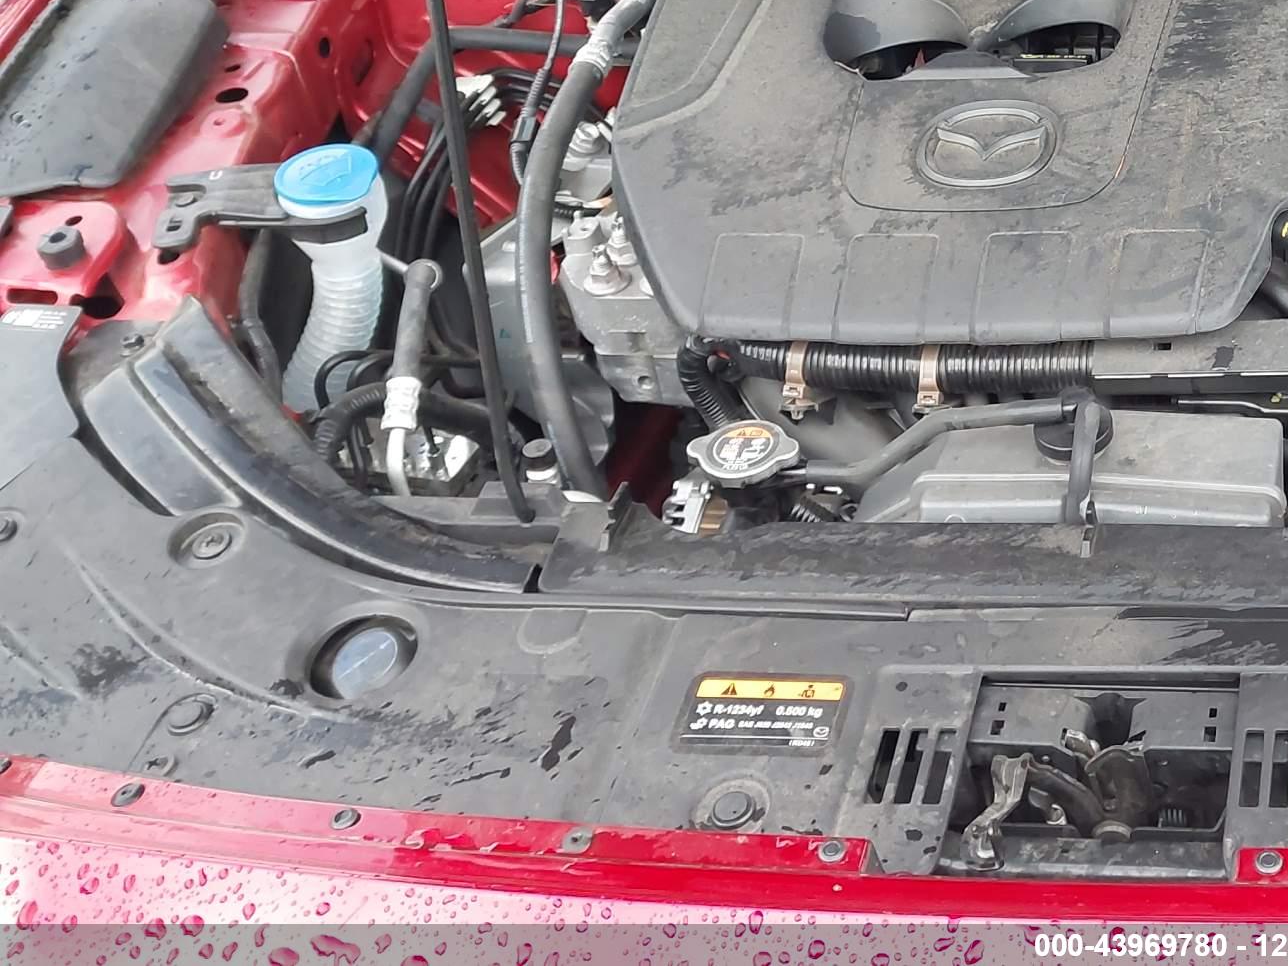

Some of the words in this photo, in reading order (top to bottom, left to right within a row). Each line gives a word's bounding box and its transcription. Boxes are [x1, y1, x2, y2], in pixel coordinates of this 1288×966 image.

[713, 704, 765, 717] R-1234yf
[807, 706, 824, 719] kg
[708, 718, 736, 729] PAG
